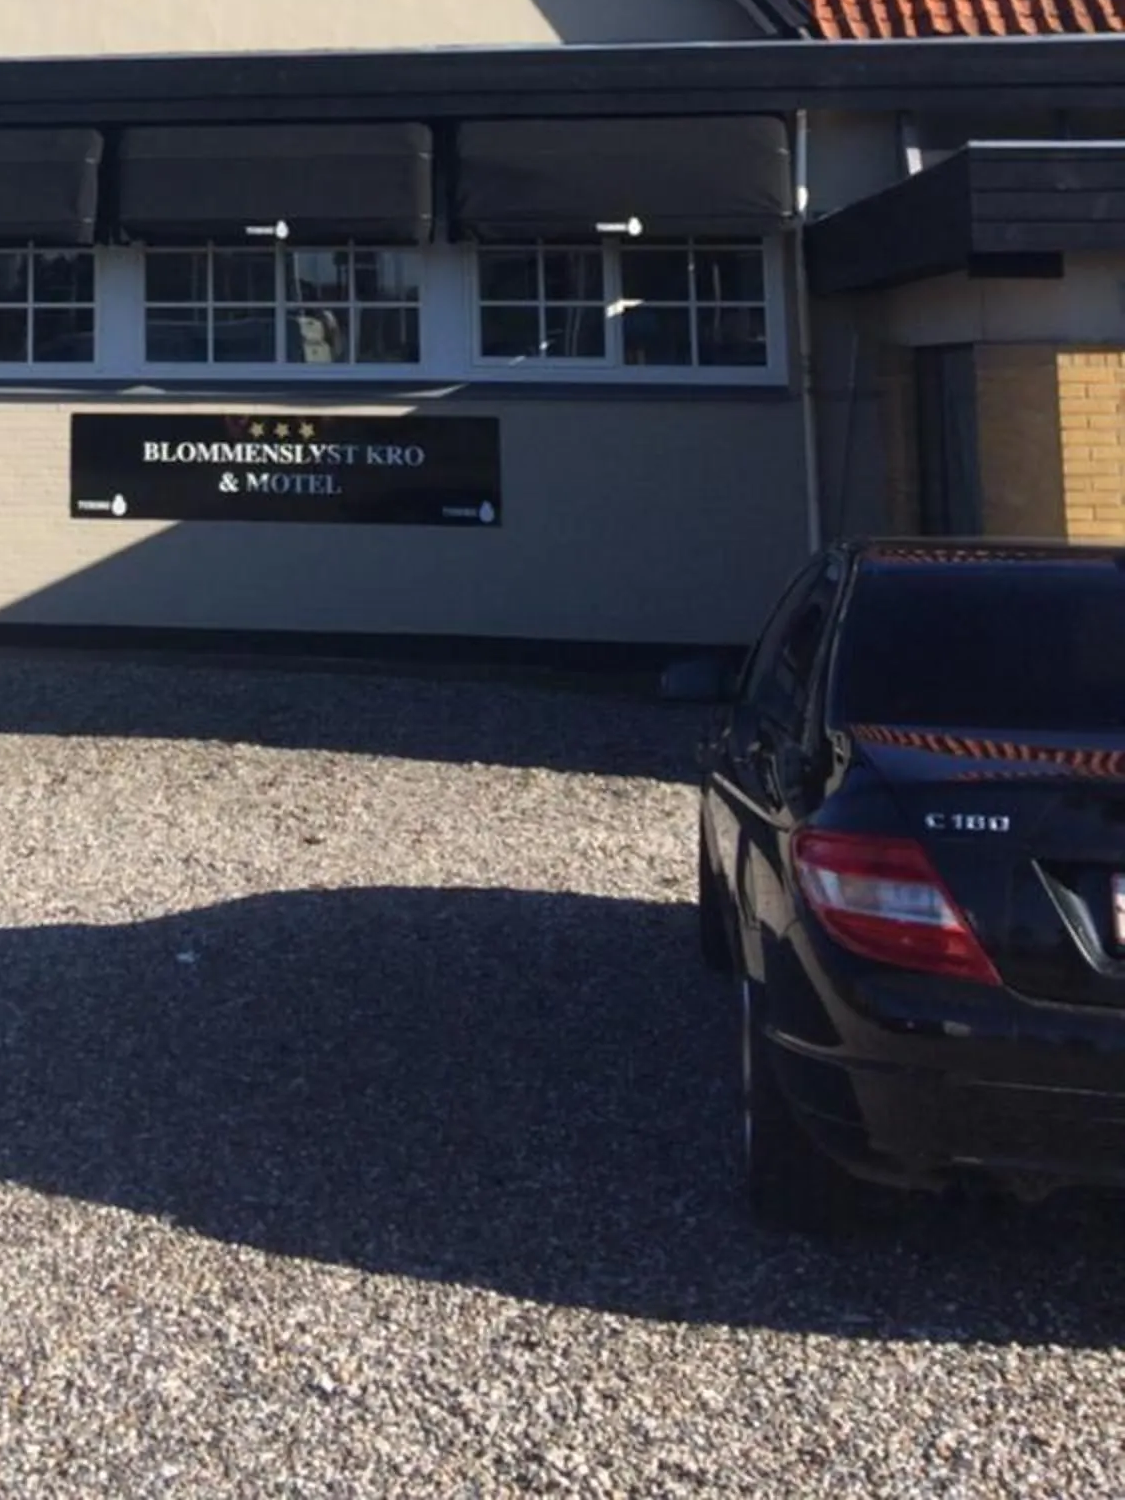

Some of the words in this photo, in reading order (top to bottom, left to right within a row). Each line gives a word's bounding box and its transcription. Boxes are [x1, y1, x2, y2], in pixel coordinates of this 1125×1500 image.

[143, 441, 359, 465] BLOMMENSLYST
[365, 445, 425, 467] KRO
[218, 473, 239, 492] &
[245, 473, 342, 494] MOTEL
